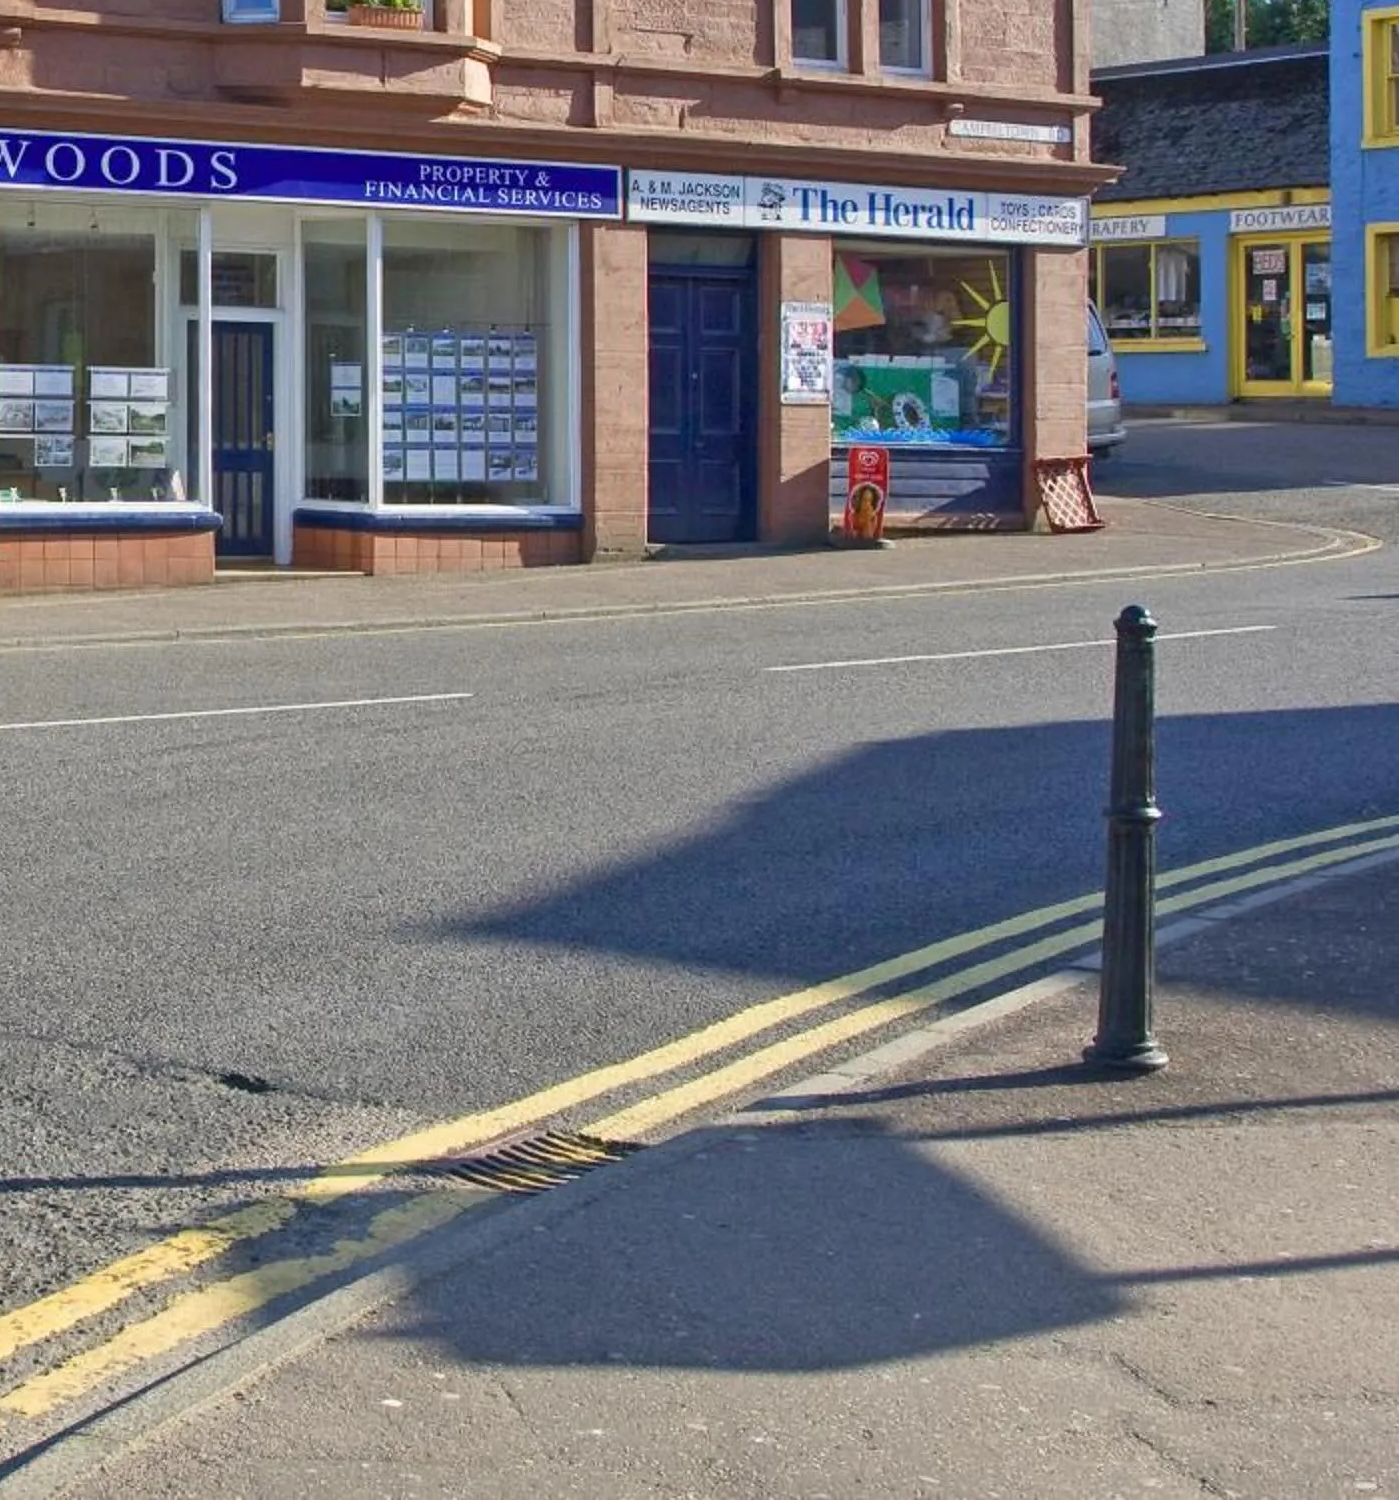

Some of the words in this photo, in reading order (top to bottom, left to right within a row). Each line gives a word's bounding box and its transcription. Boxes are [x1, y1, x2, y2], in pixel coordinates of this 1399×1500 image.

[419, 163, 530, 187] PROPERTY
[534, 170, 551, 188] &
[363, 179, 492, 204] FINANCIAL
[497, 186, 602, 210] SERVICES
[632, 178, 644, 193] A.
[660, 180, 676, 195] M.
[678, 181, 741, 199] JACKSON
[640, 196, 731, 216] NEWSAGENTS
[792, 186, 859, 225] The
[866, 190, 976, 232] Herald
[1233, 206, 1330, 227] FOOTWEAR
[1091, 218, 1149, 236] RAPERY
